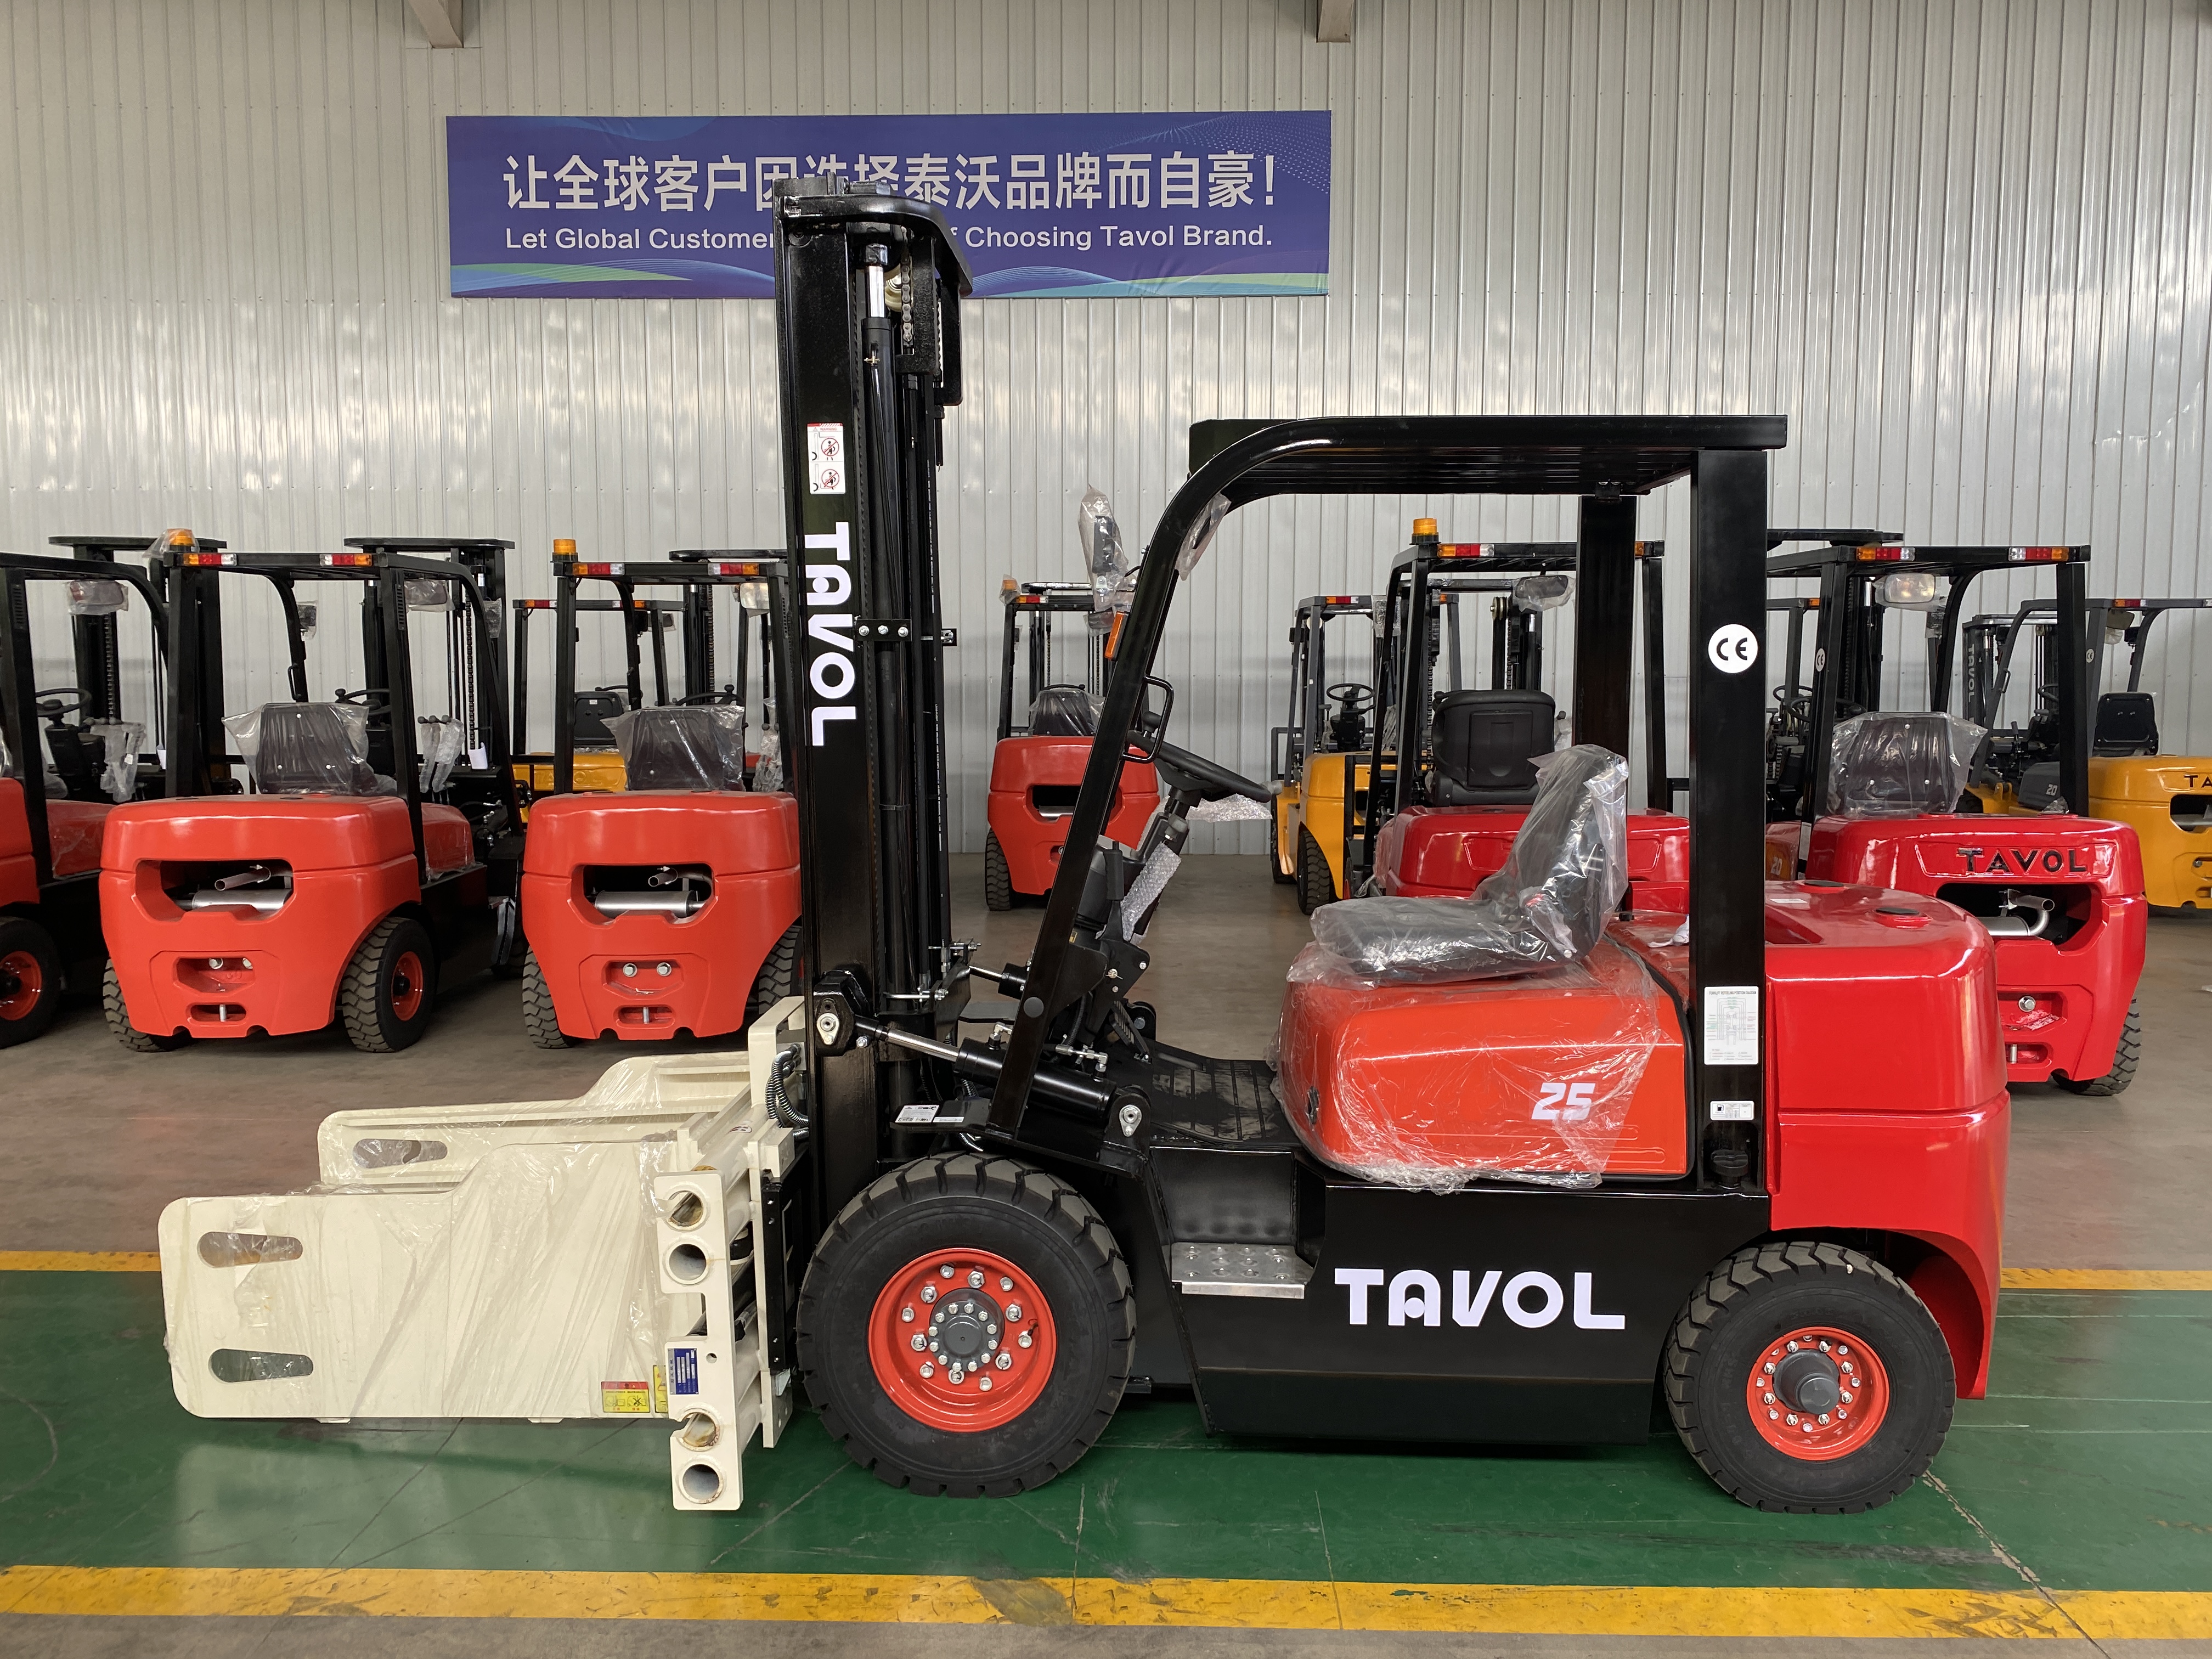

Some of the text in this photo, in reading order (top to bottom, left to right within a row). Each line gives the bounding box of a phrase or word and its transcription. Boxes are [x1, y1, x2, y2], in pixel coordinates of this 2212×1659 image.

[506, 228, 548, 249] Let
[555, 228, 640, 249] Global
[965, 226, 1091, 251] Choosing
[1100, 225, 1173, 246] Tavol
[1184, 224, 1272, 246] Brand.
[804, 521, 856, 746] TAVOL
[1716, 637, 1748, 661] CE
[2046, 783, 2058, 796] 20
[1957, 847, 2088, 874] TAVOL
[1531, 1082, 1596, 1120] 25
[1334, 1268, 1626, 1329] TAVOL
